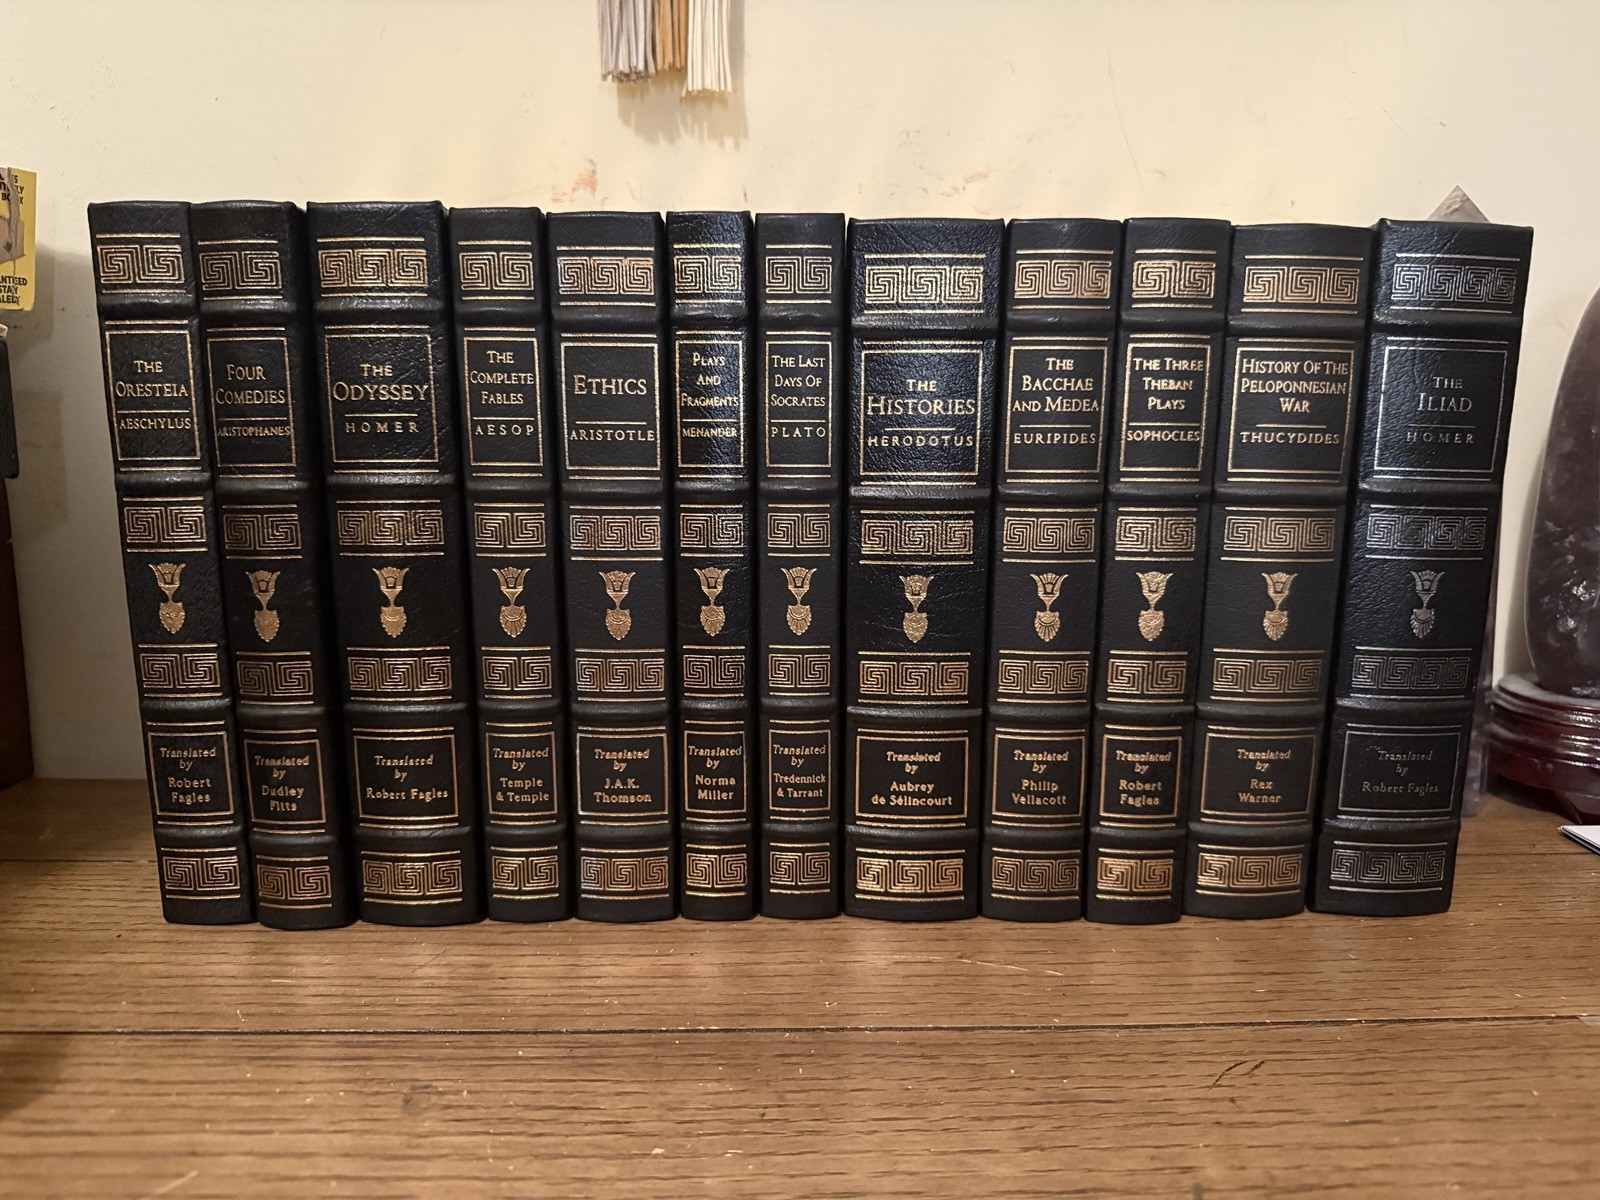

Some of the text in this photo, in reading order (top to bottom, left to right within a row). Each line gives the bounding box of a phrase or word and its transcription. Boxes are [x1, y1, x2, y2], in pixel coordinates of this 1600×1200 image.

[486, 350, 515, 364] THE
[692, 352, 725, 366] PLAYS
[771, 355, 826, 368] THE LAST
[134, 360, 163, 373] THE
[360, 363, 393, 377] THE
[1046, 357, 1074, 371] THE
[1133, 357, 1204, 371] THE THREE
[1241, 358, 1349, 376] HISTORY OF THE
[227, 364, 266, 380] FOUR
[470, 370, 534, 384] COMPLETE
[573, 374, 648, 395] ETHICS
[696, 375, 720, 386] AND
[775, 375, 823, 388] DAYS OF
[906, 379, 937, 392] THE
[1021, 374, 1093, 391] BACCHAE
[1142, 377, 1193, 391] THEBAN
[1241, 377, 1347, 395] PELOPONNESIAN
[1432, 376, 1463, 390] THE
[115, 381, 188, 397] ORESTEIA
[332, 381, 428, 401] ODYSSEY
[215, 388, 286, 405] COMEDIES
[481, 391, 524, 405] FABLES
[681, 393, 739, 406] FRAGMENTS
[770, 394, 826, 407] SOCRATES
[1416, 392, 1472, 413] ILIAD
[866, 396, 975, 416] HISTORIES
[1012, 396, 1099, 412] AND MEDEA
[1147, 397, 1185, 411] PLAYS
[1279, 397, 1310, 414] WAR
[119, 418, 191, 430] AESCHYLUS
[345, 422, 419, 433] HOMER
[475, 424, 534, 436] AESOP
[218, 426, 291, 437] ARISTOPHANES
[570, 429, 655, 441] ARISTOTLE
[682, 427, 737, 438] MENANDER
[771, 427, 826, 438] PLATO
[1126, 430, 1200, 442] SOPHOCLES
[1239, 431, 1340, 445] THUCYDIDES
[867, 435, 974, 447] HERODOTUS
[1013, 433, 1096, 444] EURIPIDES
[1406, 432, 1474, 445] HOMER
[160, 746, 217, 758] Translated
[493, 747, 549, 759] Translated
[594, 748, 650, 760] Translated
[688, 745, 742, 757] Translated
[773, 744, 826, 755] Translated
[1013, 749, 1069, 762] Translated
[1115, 750, 1172, 762] Translated
[1237, 749, 1291, 760] Translated
[1377, 750, 1433, 761] Translated
[254, 755, 310, 766] Translated
[374, 754, 434, 766] Translated
[706, 757, 720, 769] by
[790, 755, 805, 768] by
[886, 751, 942, 762] Translated
[179, 759, 193, 771] by
[511, 759, 525, 772] by
[613, 760, 627, 772] by
[904, 763, 919, 775] by
[1032, 762, 1047, 773] by
[1134, 763, 1149, 774] by
[1255, 760, 1270, 773] by
[1396, 763, 1409, 777] by
[272, 767, 287, 779] by
[394, 769, 408, 782] by
[773, 772, 826, 784] Tredennick
[168, 776, 212, 788] Robert
[500, 777, 543, 790] Temple
[604, 778, 640, 789] J.A.K.
[695, 774, 736, 786] Norma
[1020, 778, 1059, 793] Philip
[1118, 779, 1163, 791] Robert
[1250, 778, 1273, 790] Rex
[261, 784, 305, 799] Dudley
[776, 787, 824, 798] & Tarrant
[890, 781, 935, 794] Aubrey
[1361, 781, 1439, 797] Robert Fagles
[171, 791, 211, 805] Fagles
[366, 787, 448, 802] Robert Fagles
[495, 791, 550, 804] & Temple
[593, 791, 652, 803] Thomson
[697, 789, 734, 800] Miller
[871, 794, 952, 806] de Sélincourt
[1011, 792, 1066, 806] Vellacott
[1119, 793, 1160, 807] Fagles
[1238, 792, 1282, 803] Warner
[270, 800, 298, 812] Fitts
